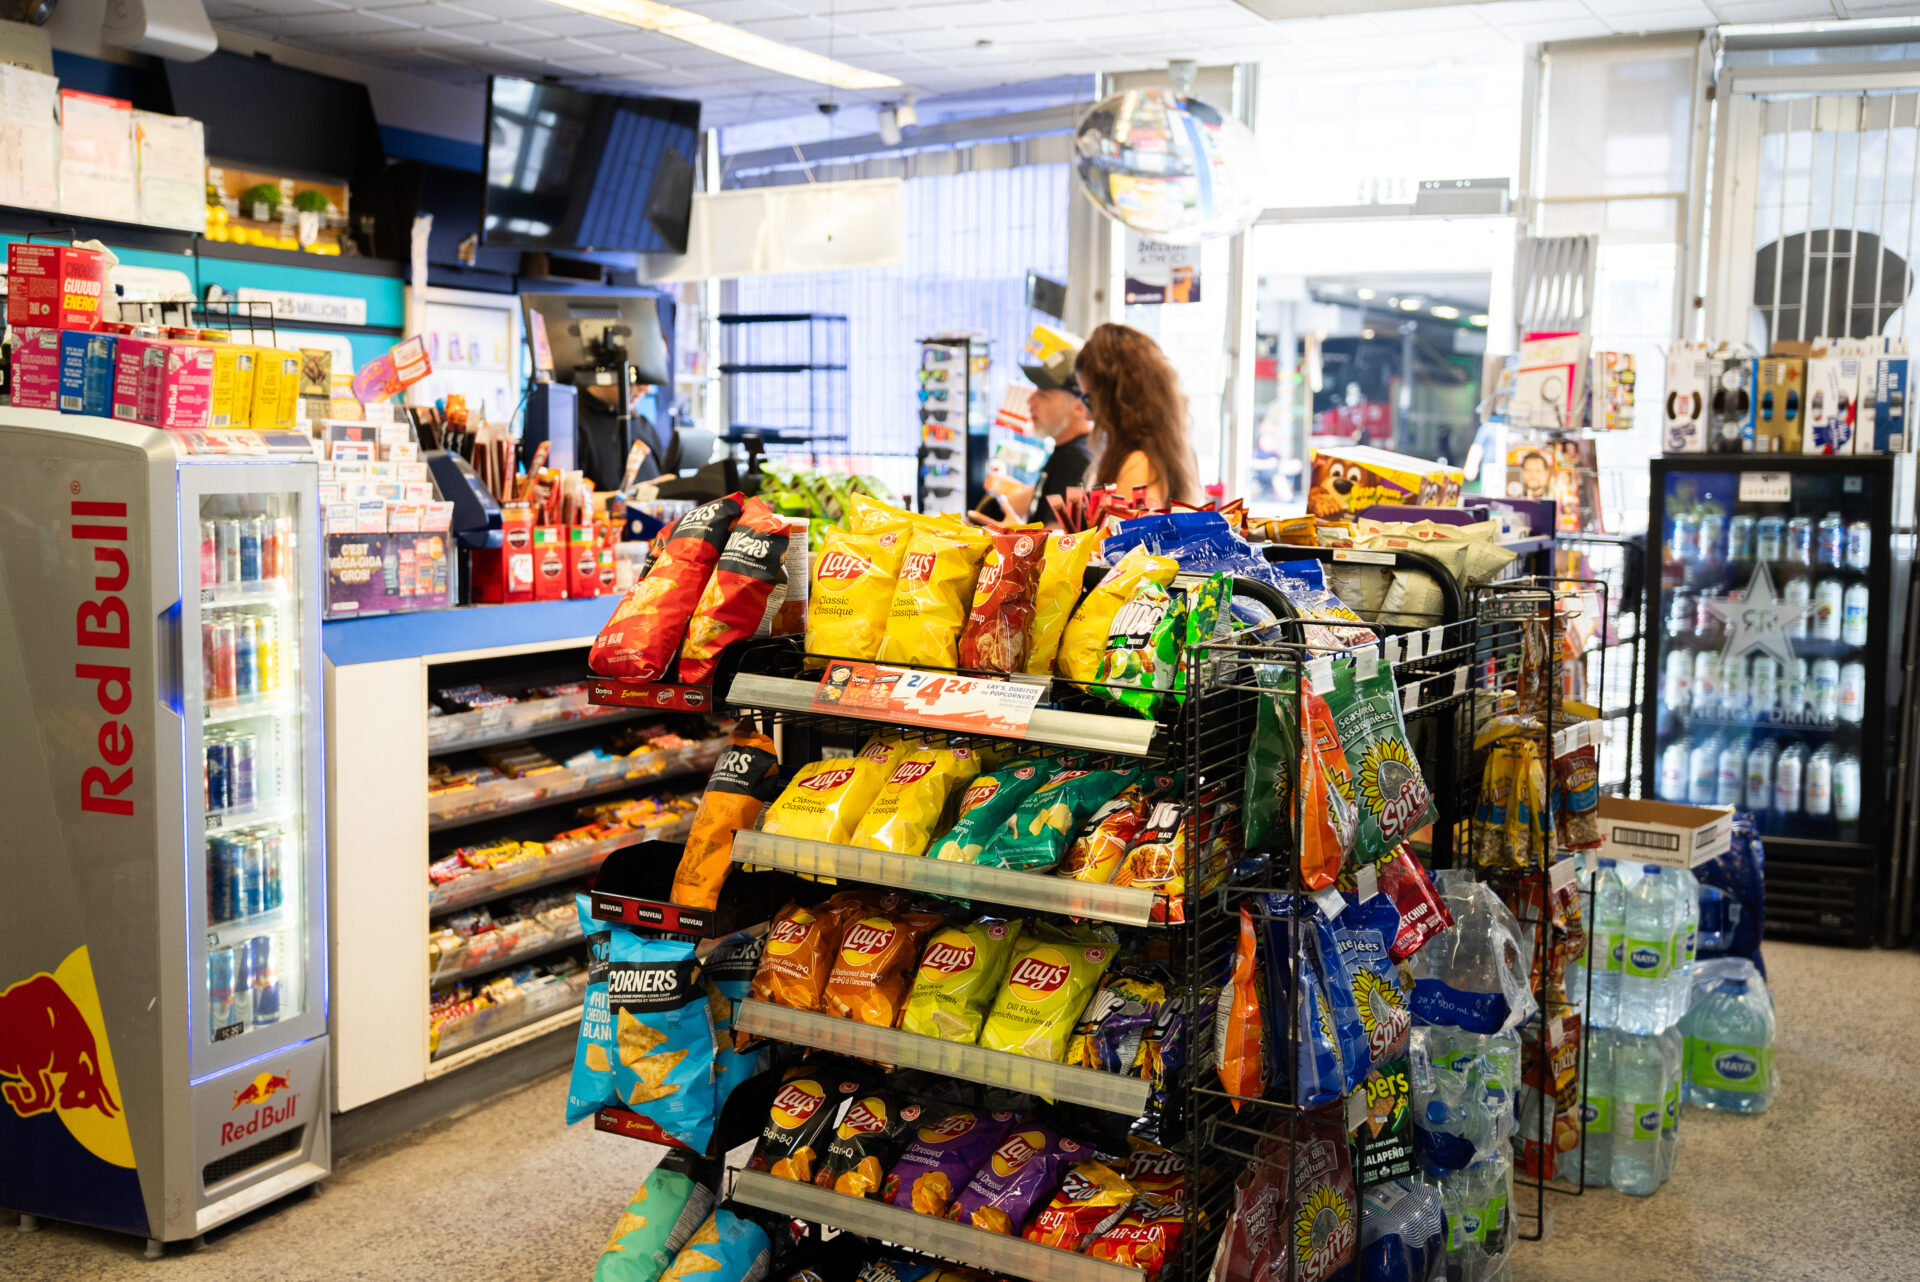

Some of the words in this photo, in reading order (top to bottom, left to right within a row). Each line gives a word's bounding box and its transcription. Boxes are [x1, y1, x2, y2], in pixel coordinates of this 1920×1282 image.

[63, 294, 100, 312] ENERGY
[278, 298, 295, 314] 25
[297, 300, 348, 318] MILLIONS
[12, 363, 21, 383] Bull
[12, 383, 21, 404] Red
[168, 384, 179, 404] Bull
[166, 404, 176, 426] Red
[680, 503, 720, 525] ERS
[341, 543, 369, 557] C'EST
[725, 531, 770, 559] NERS
[71, 500, 131, 650] Bull
[340, 568, 371, 581] GROS!
[977, 564, 1001, 594] ay's
[820, 595, 850, 606] Classic
[894, 597, 918, 608] Classic
[814, 606, 854, 618] Classique
[889, 608, 920, 619] Classique
[968, 611, 986, 625] chup
[594, 687, 613, 695] Doritos
[989, 690, 1036, 701] POPCORNERS
[1008, 686, 1039, 695] DORITOS
[1338, 702, 1375, 730] Seased
[1690, 706, 1758, 721] NERGY
[1338, 711, 1394, 745] Assainées
[75, 663, 134, 816] Red
[719, 751, 752, 774] ERS
[891, 761, 935, 784] Lay's
[806, 768, 853, 791] Lay's
[781, 802, 826, 814] Classique
[792, 796, 825, 806] Classic
[876, 797, 899, 806] Classic
[1382, 776, 1427, 838] Spitz
[599, 903, 622, 913] NOUVEAU
[638, 910, 662, 920] NOUVEAU
[679, 917, 703, 927] NOUVEAU
[770, 920, 806, 943] Lay's
[843, 924, 892, 954] Lay's
[923, 944, 974, 973] Lay's
[1632, 953, 1658, 965] NAYA
[608, 969, 678, 992] CORNERS
[835, 968, 859, 977] Fashioned
[1012, 959, 1067, 990] Lay's
[1006, 1002, 1018, 1011] Dill
[1019, 1005, 1041, 1016] Pickle
[1417, 996, 1428, 1005] 28
[1371, 1004, 1409, 1058] Spitz
[1719, 1060, 1752, 1074] NAYA
[775, 1086, 820, 1116] Lay's
[220, 1109, 259, 1147] Red
[261, 1093, 298, 1131] Bull
[763, 1126, 794, 1147] Bar-B-Q
[902, 1153, 940, 1168] aisonnées
[911, 1144, 945, 1159] Dressed
[1311, 1145, 1326, 1160] BBQ
[1127, 1150, 1185, 1180] Frito
[1039, 1211, 1065, 1230] -B-Q
[1246, 1205, 1266, 1227] Smok
[1305, 1219, 1353, 1280] Spitz
